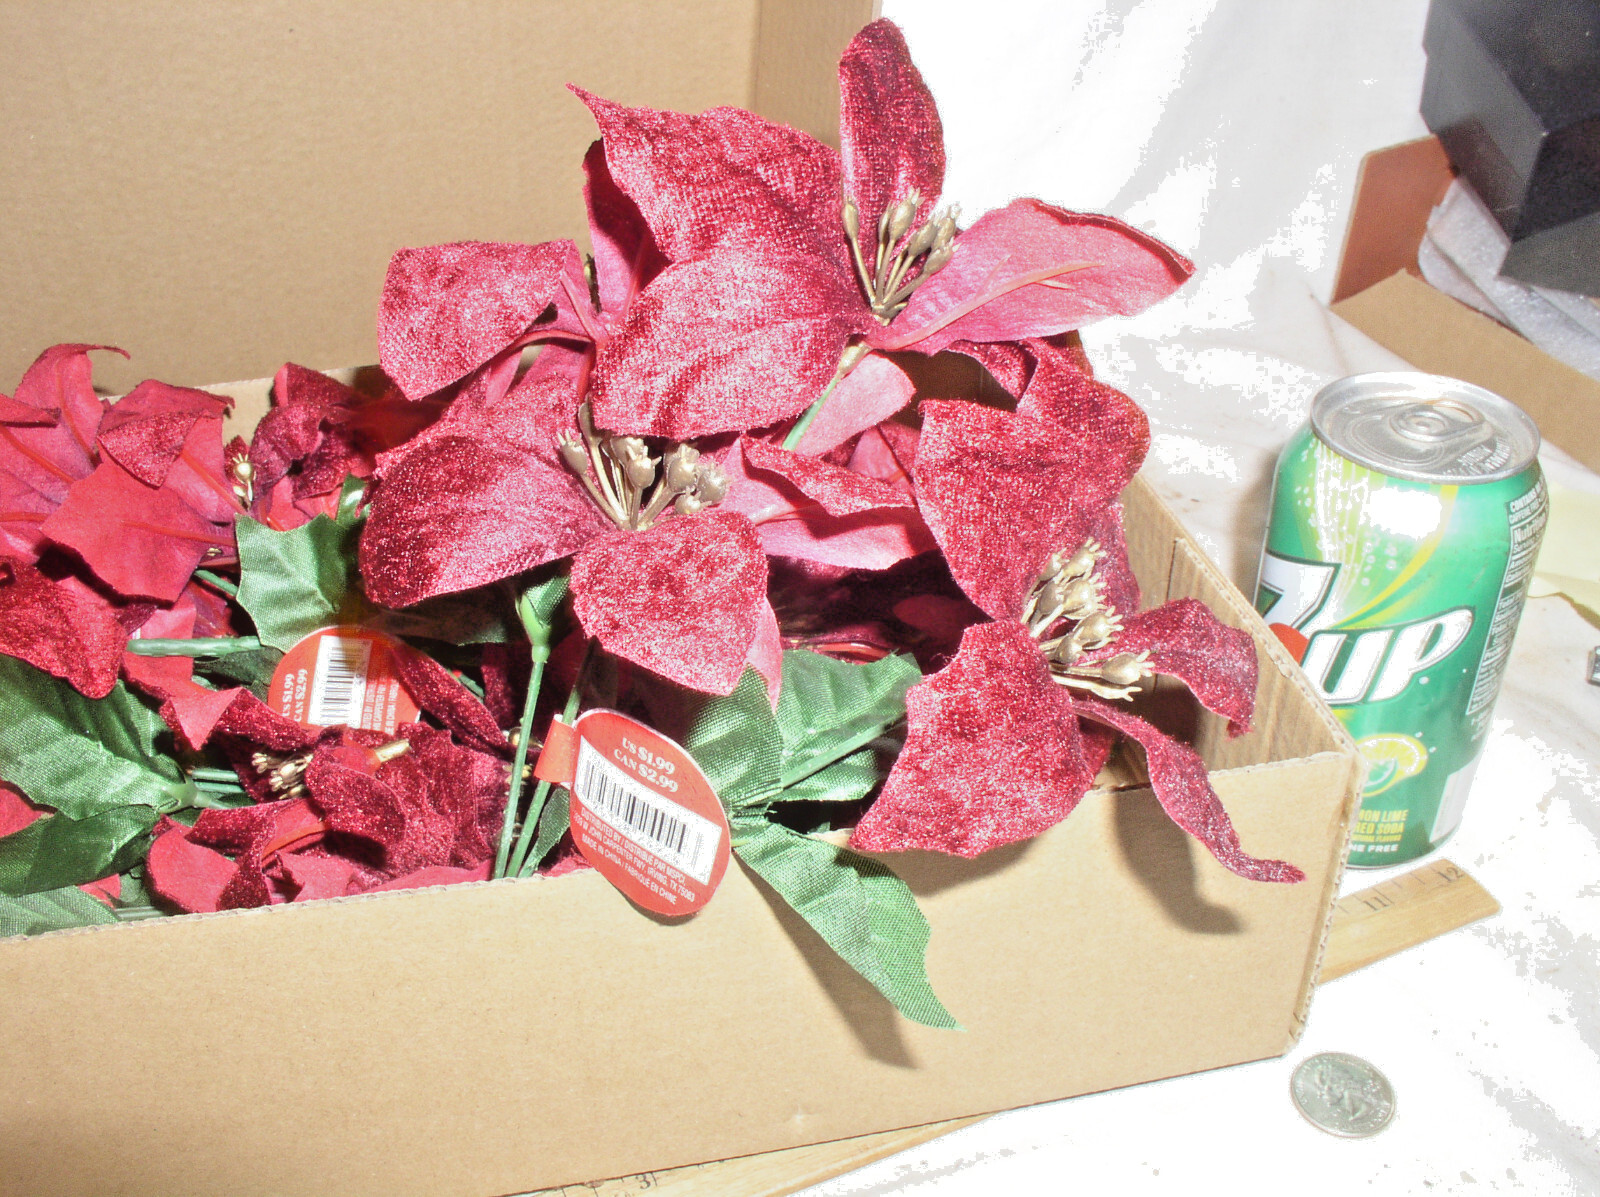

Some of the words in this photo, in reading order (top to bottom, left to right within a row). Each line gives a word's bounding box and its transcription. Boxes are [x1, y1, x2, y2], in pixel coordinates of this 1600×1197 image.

[282, 673, 295, 703] $1.99
[294, 669, 308, 700] $2.99
[294, 701, 304, 722] CAN
[622, 737, 637, 754] US
[637, 747, 676, 775] $1.99
[614, 749, 637, 770] CAN
[638, 763, 678, 793] $2.99
[1376, 822, 1404, 834] SODA
[1381, 809, 1408, 823] LIME
[581, 807, 613, 838] DISTRIBUTED
[613, 831, 622, 842] BY
[653, 858, 666, 873] PAR
[1367, 844, 1399, 853] FREE
[582, 833, 597, 851] MADE
[598, 845, 604, 855] IN
[604, 849, 622, 866] CHINA
[650, 882, 659, 894] EN
[659, 887, 677, 905] CHINE
[588, 826, 603, 842] JOHN
[603, 836, 633, 862] CARPENTER
[670, 879, 678, 892] TX
[1437, 866, 1464, 883] 12
[1363, 896, 1388, 911] 11
[635, 1173, 651, 1189] 3
